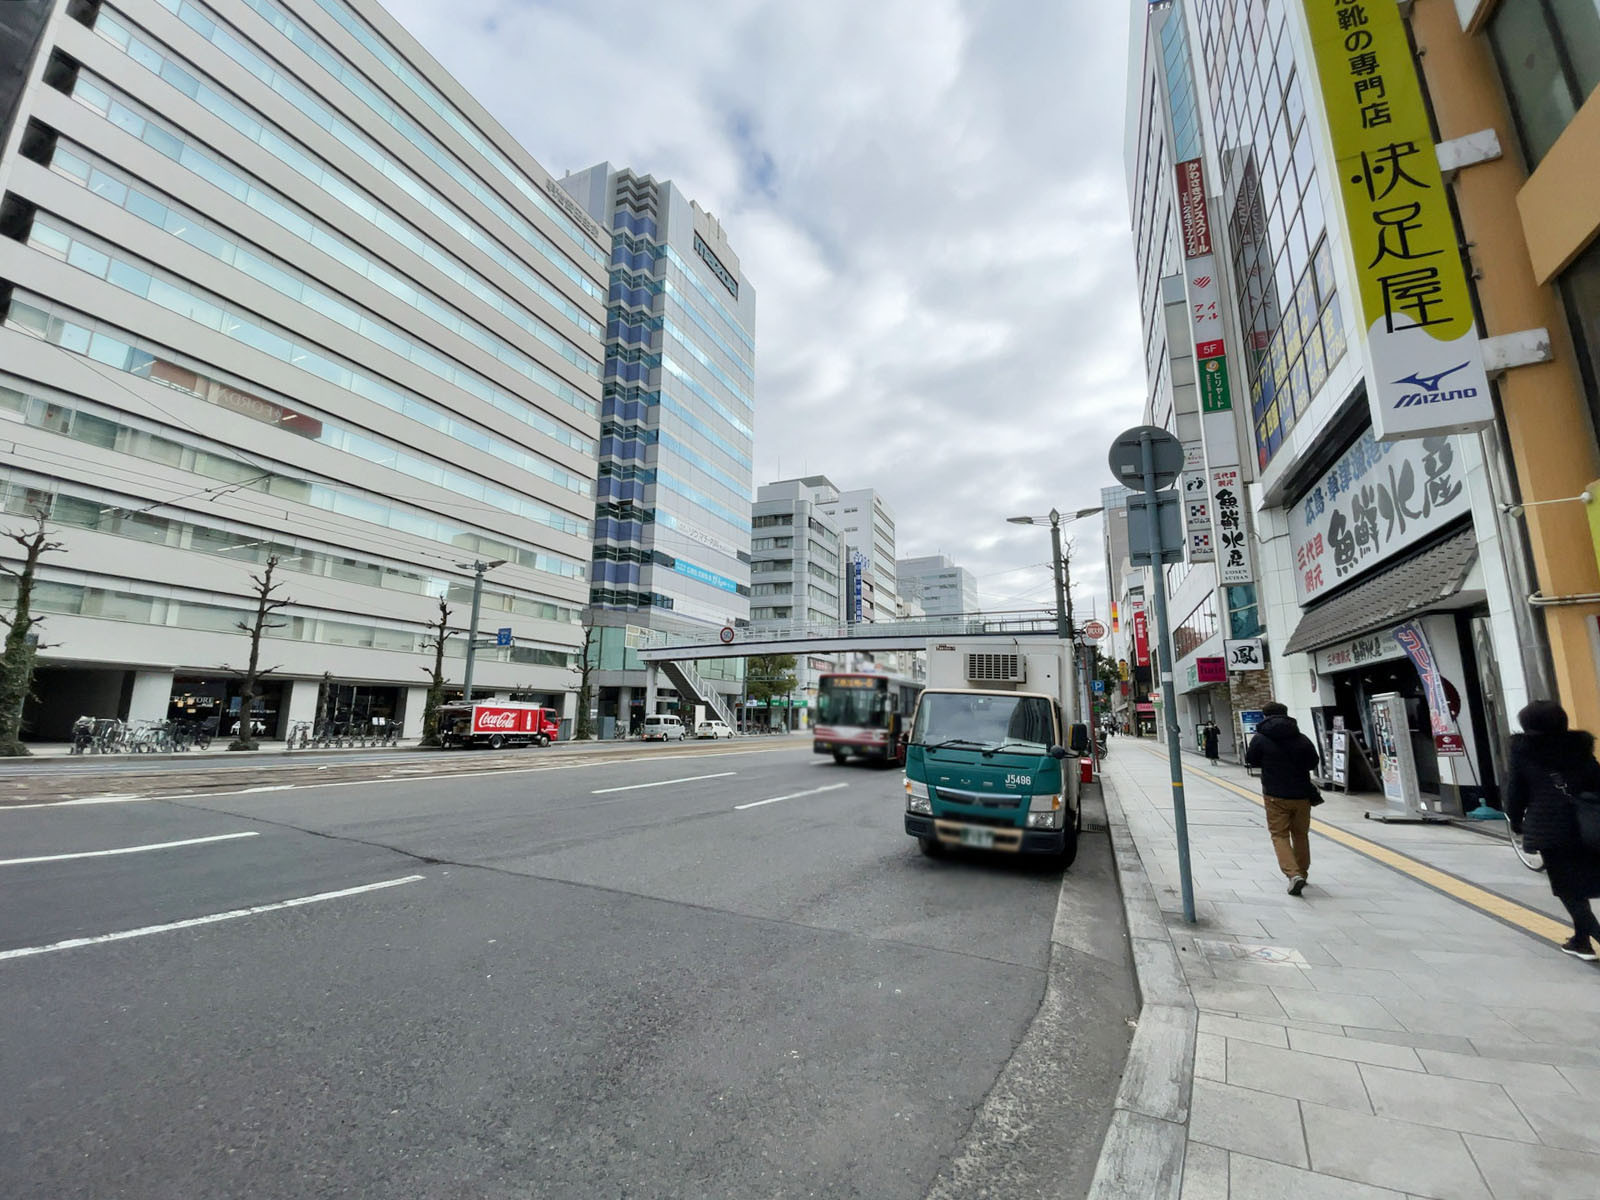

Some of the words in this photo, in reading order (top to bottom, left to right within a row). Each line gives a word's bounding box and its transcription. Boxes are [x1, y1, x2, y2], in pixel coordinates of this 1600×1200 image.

[1334, 0, 1392, 129] 靴の専門店
[1351, 141, 1454, 334] 快足屋
[1203, 344, 1217, 354] 5F
[1297, 532, 1324, 571] 三代目
[1305, 563, 1324, 593] 網元
